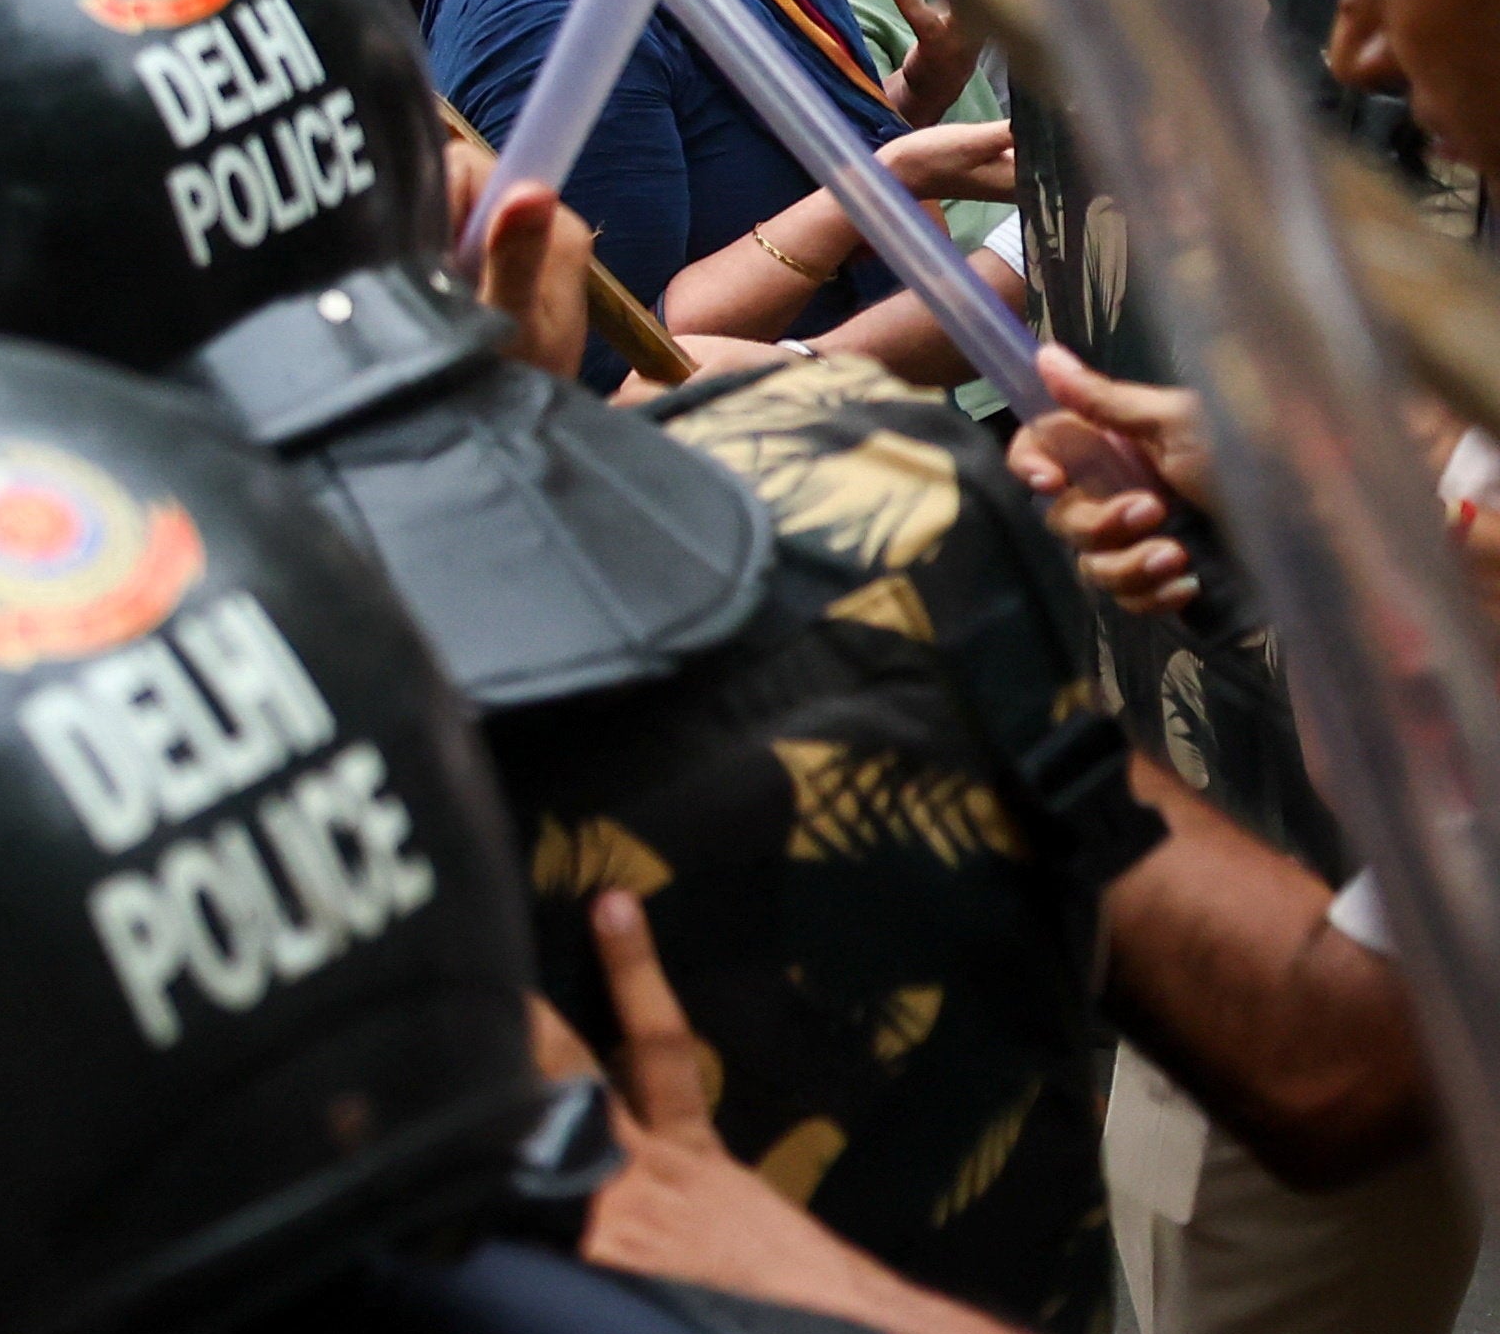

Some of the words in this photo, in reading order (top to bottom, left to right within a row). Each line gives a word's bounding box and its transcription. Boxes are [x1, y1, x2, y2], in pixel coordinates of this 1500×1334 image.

[164, 87, 377, 267] POLICE
[16, 591, 336, 855] DELHI
[86, 741, 436, 1049] POLICE
